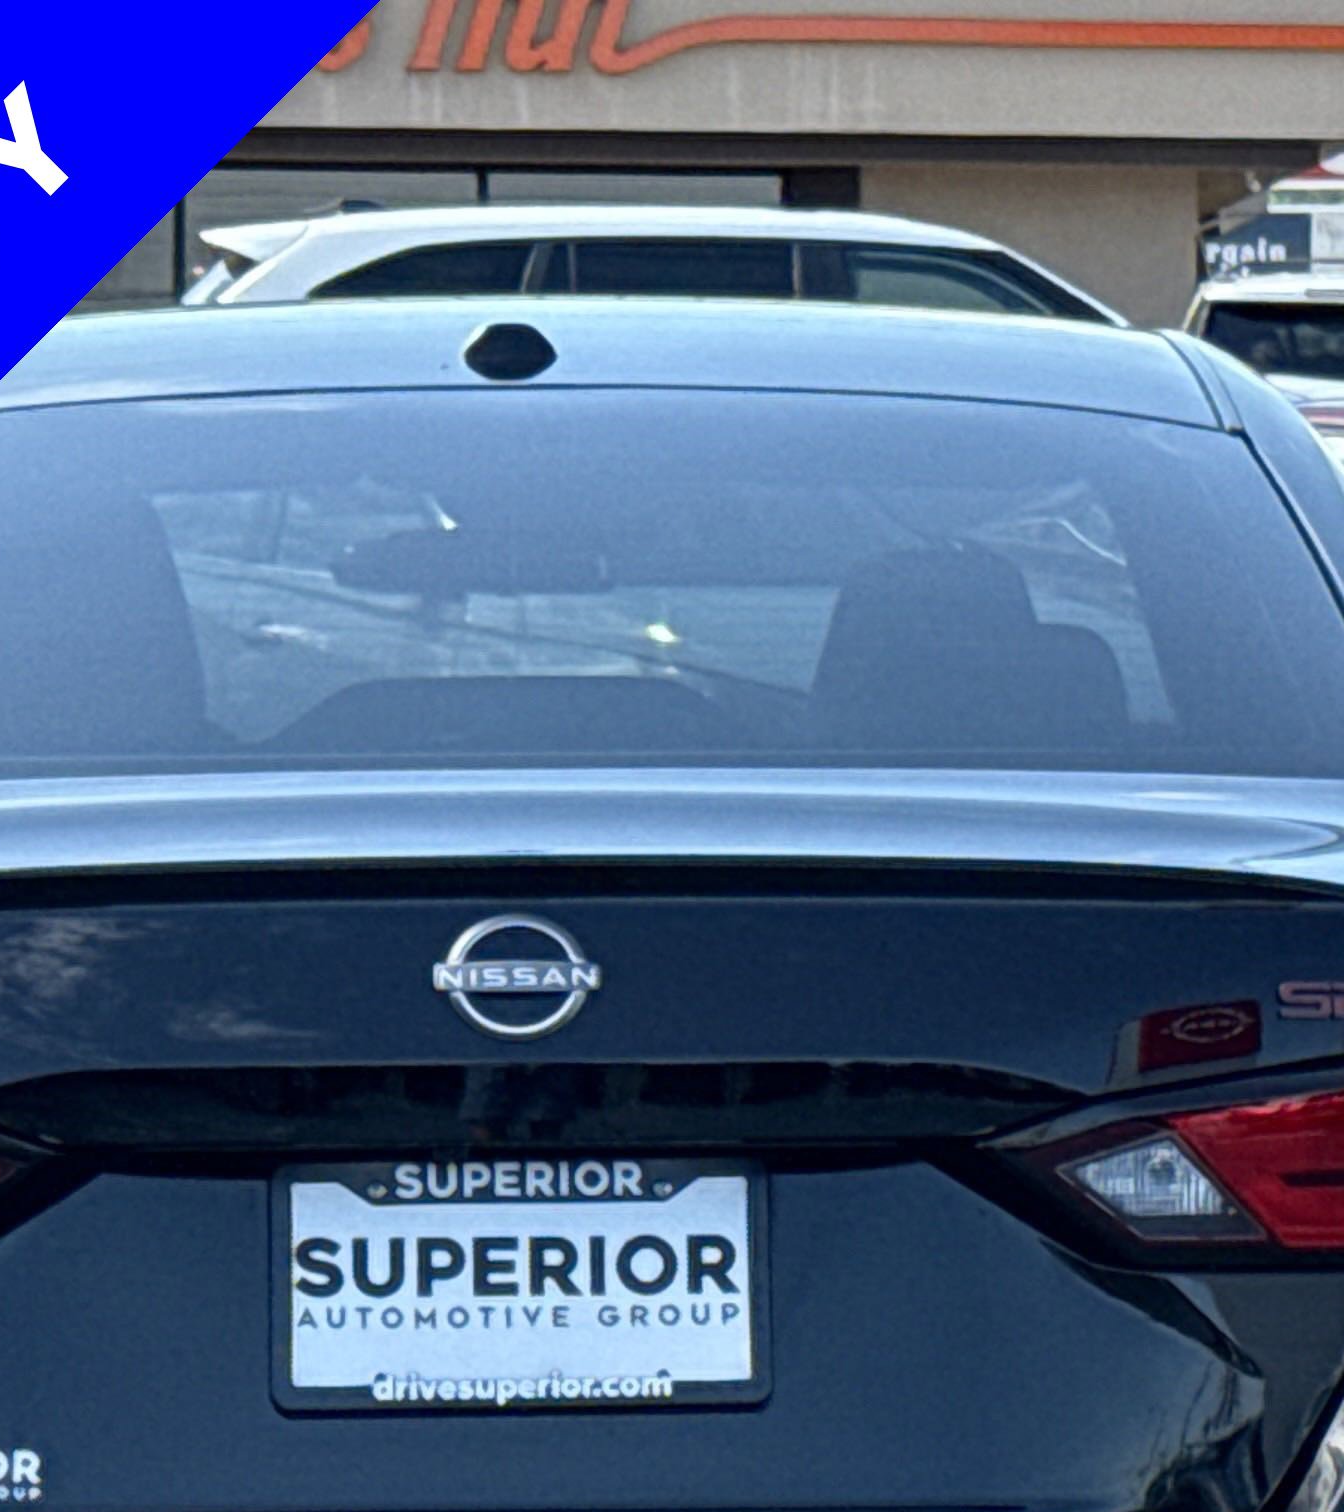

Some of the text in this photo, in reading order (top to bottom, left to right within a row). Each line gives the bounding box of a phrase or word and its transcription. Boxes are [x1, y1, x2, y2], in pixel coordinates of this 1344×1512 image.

[1205, 236, 1288, 272] rgain
[437, 966, 598, 988] NISSAN
[393, 1160, 644, 1199] SUPERIOR
[294, 1234, 742, 1299] SUPERIOR
[296, 1302, 742, 1330] AUTOMOTIVE GROUP
[371, 1369, 674, 1406] drivesuperior.com
